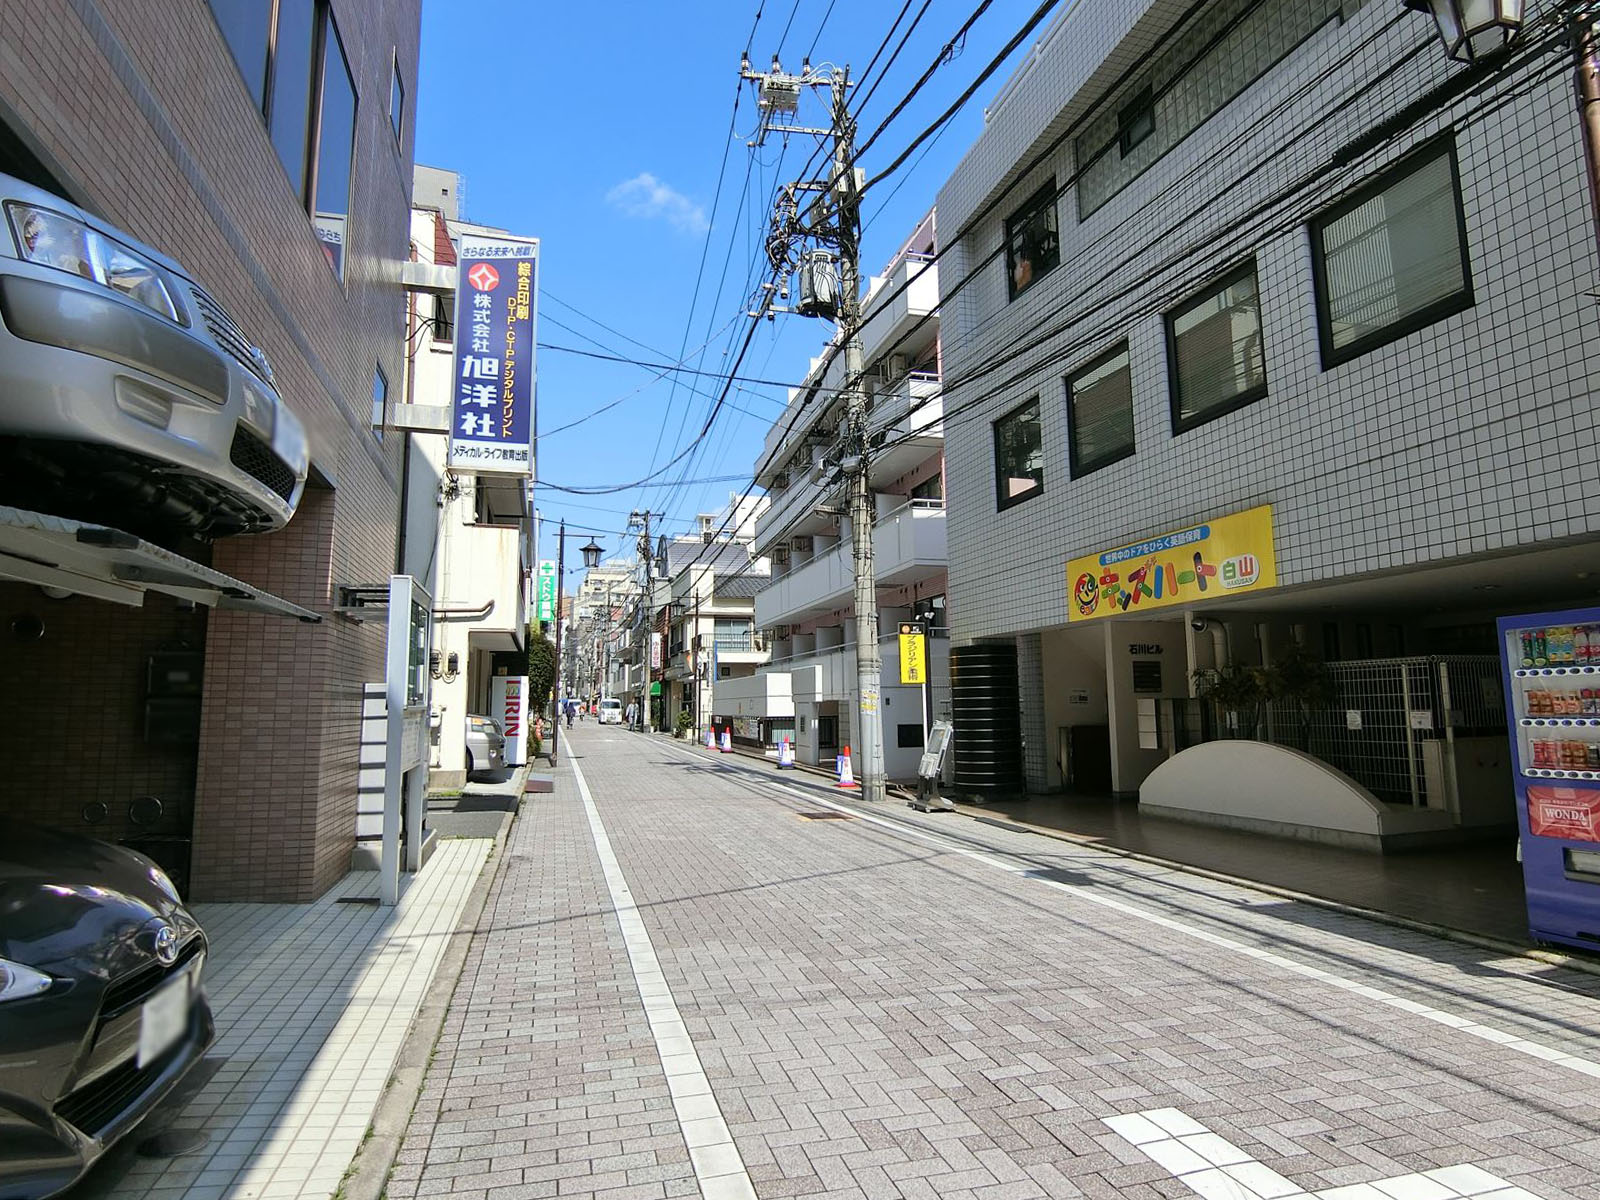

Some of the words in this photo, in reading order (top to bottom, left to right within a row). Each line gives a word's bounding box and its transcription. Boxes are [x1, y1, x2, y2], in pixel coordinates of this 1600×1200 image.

[472, 293, 492, 353] 株式会社
[460, 355, 499, 437] 旭洋社
[1099, 552, 1217, 611] キッズハート
[1223, 556, 1254, 581] 白山
[1544, 808, 1585, 821] WONDA
